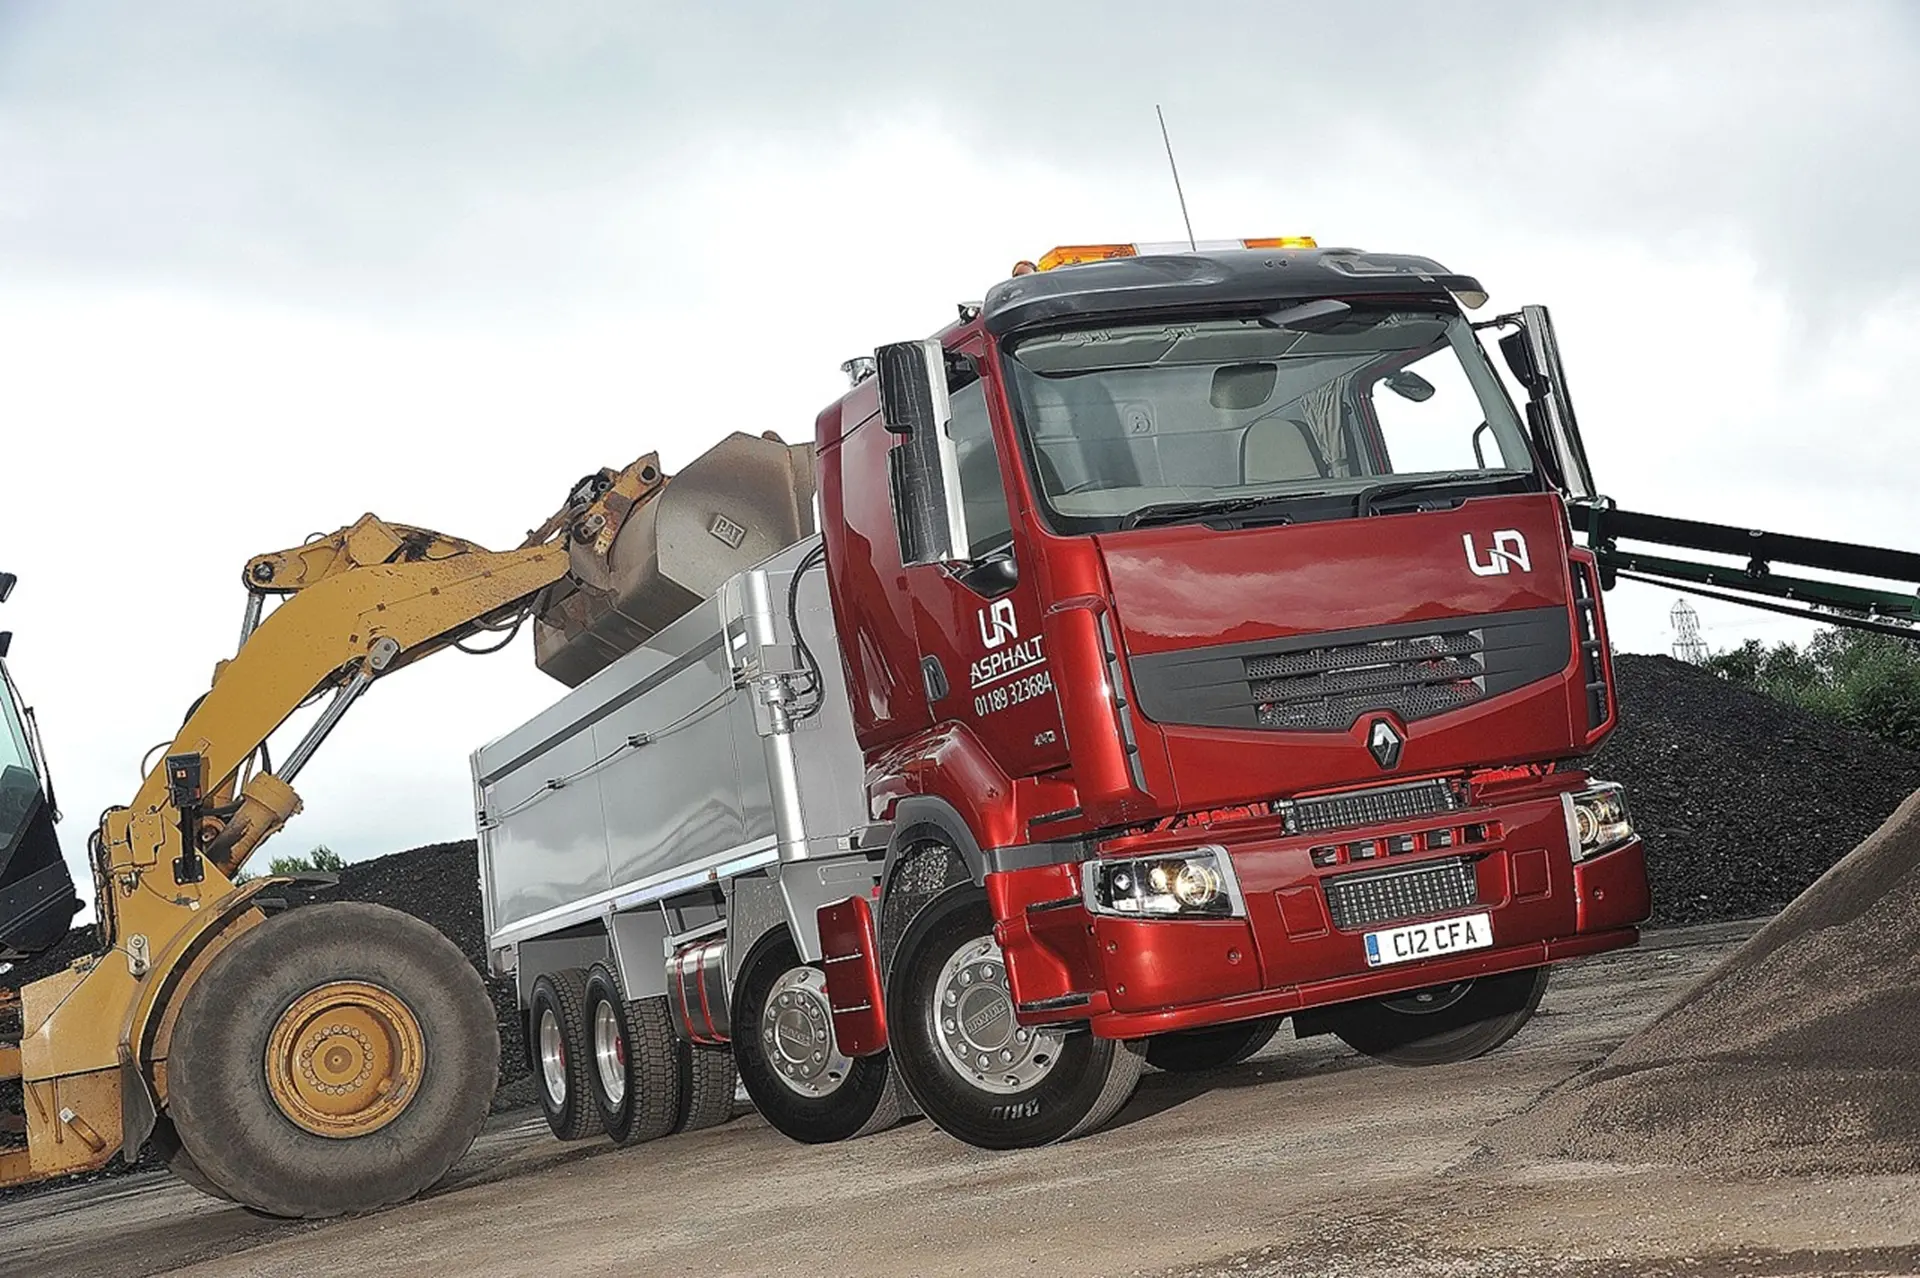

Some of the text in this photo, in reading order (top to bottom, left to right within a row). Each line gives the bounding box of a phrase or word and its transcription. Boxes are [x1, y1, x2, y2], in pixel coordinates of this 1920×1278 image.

[714, 519, 743, 543] CAT
[969, 635, 1043, 685] ASPHALT
[974, 670, 1053, 717] 01189 323684
[1393, 920, 1477, 957] C12 CFA
